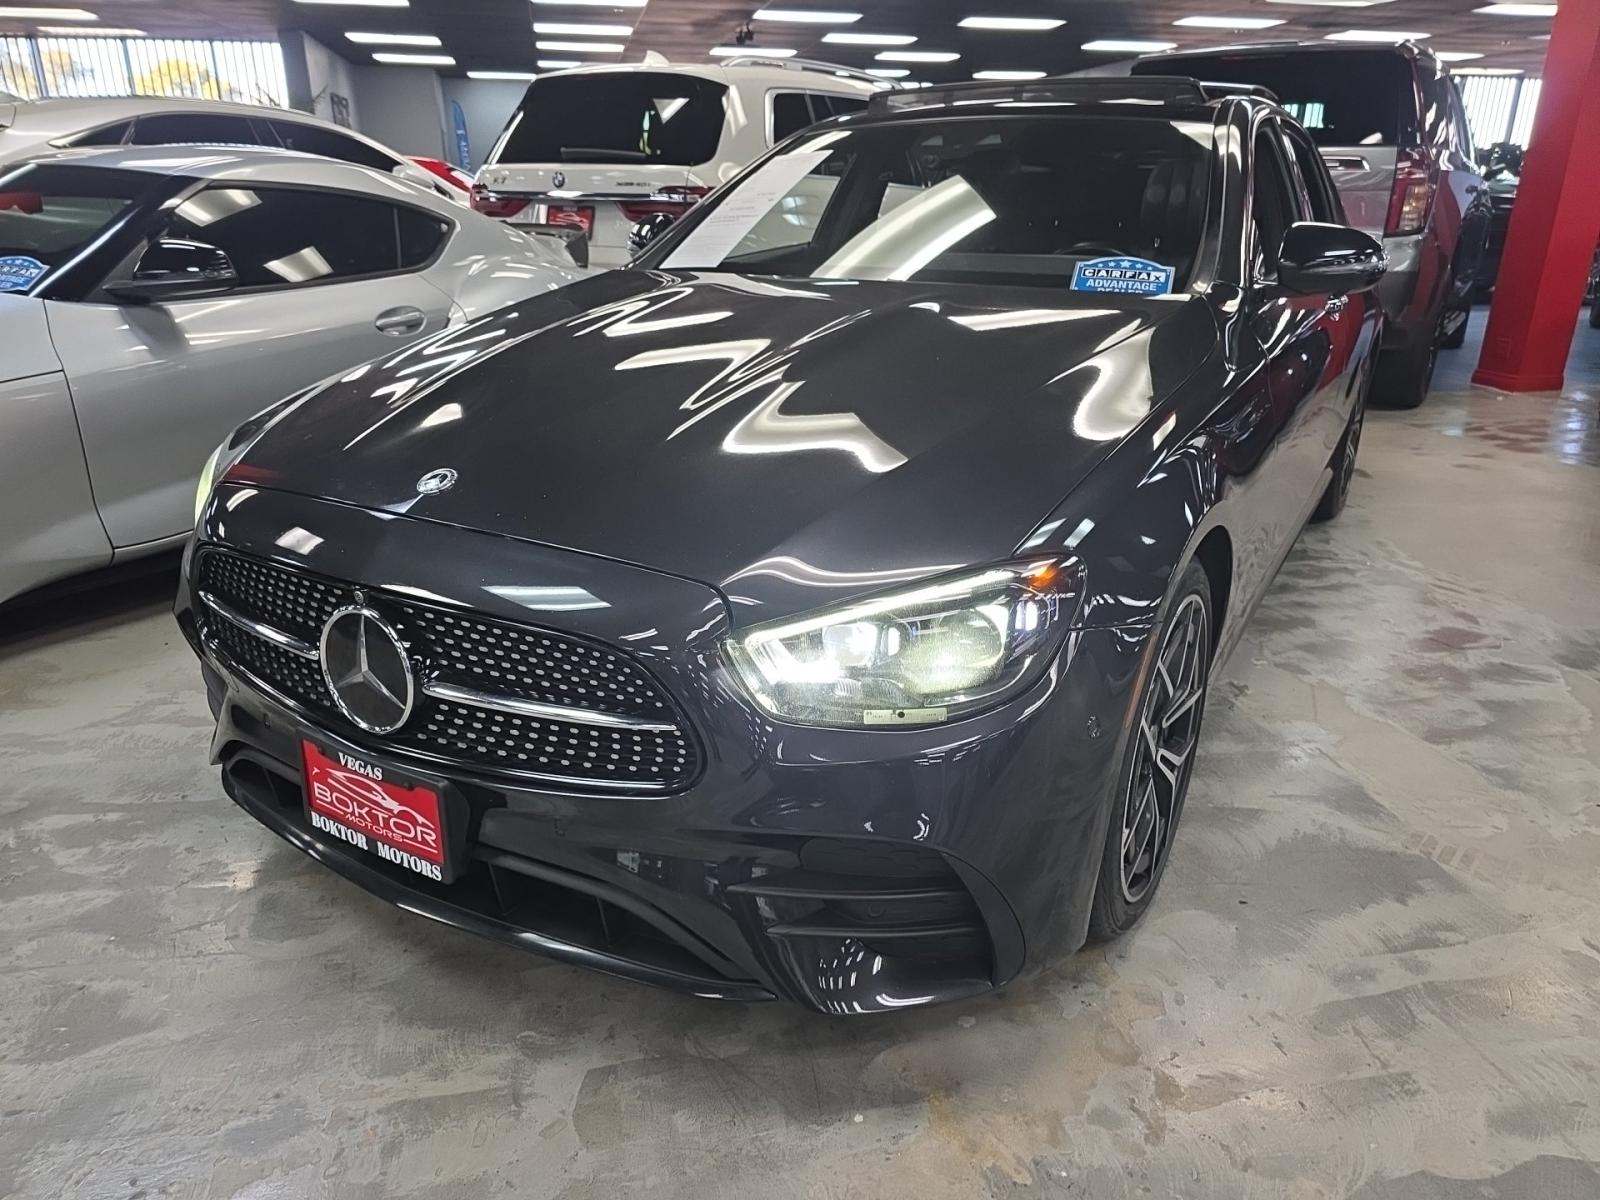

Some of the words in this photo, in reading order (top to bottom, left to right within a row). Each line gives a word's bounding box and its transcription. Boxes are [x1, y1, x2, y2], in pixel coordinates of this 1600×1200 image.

[1084, 268, 1166, 282] CARFAX
[1086, 279, 1157, 291] ADVANTAGE
[338, 752, 383, 781] VEGAS
[313, 781, 437, 848] BOKTOR
[345, 815, 403, 843] MOTORS
[311, 811, 369, 850] BOKTOR
[377, 841, 443, 881] MOTORS
